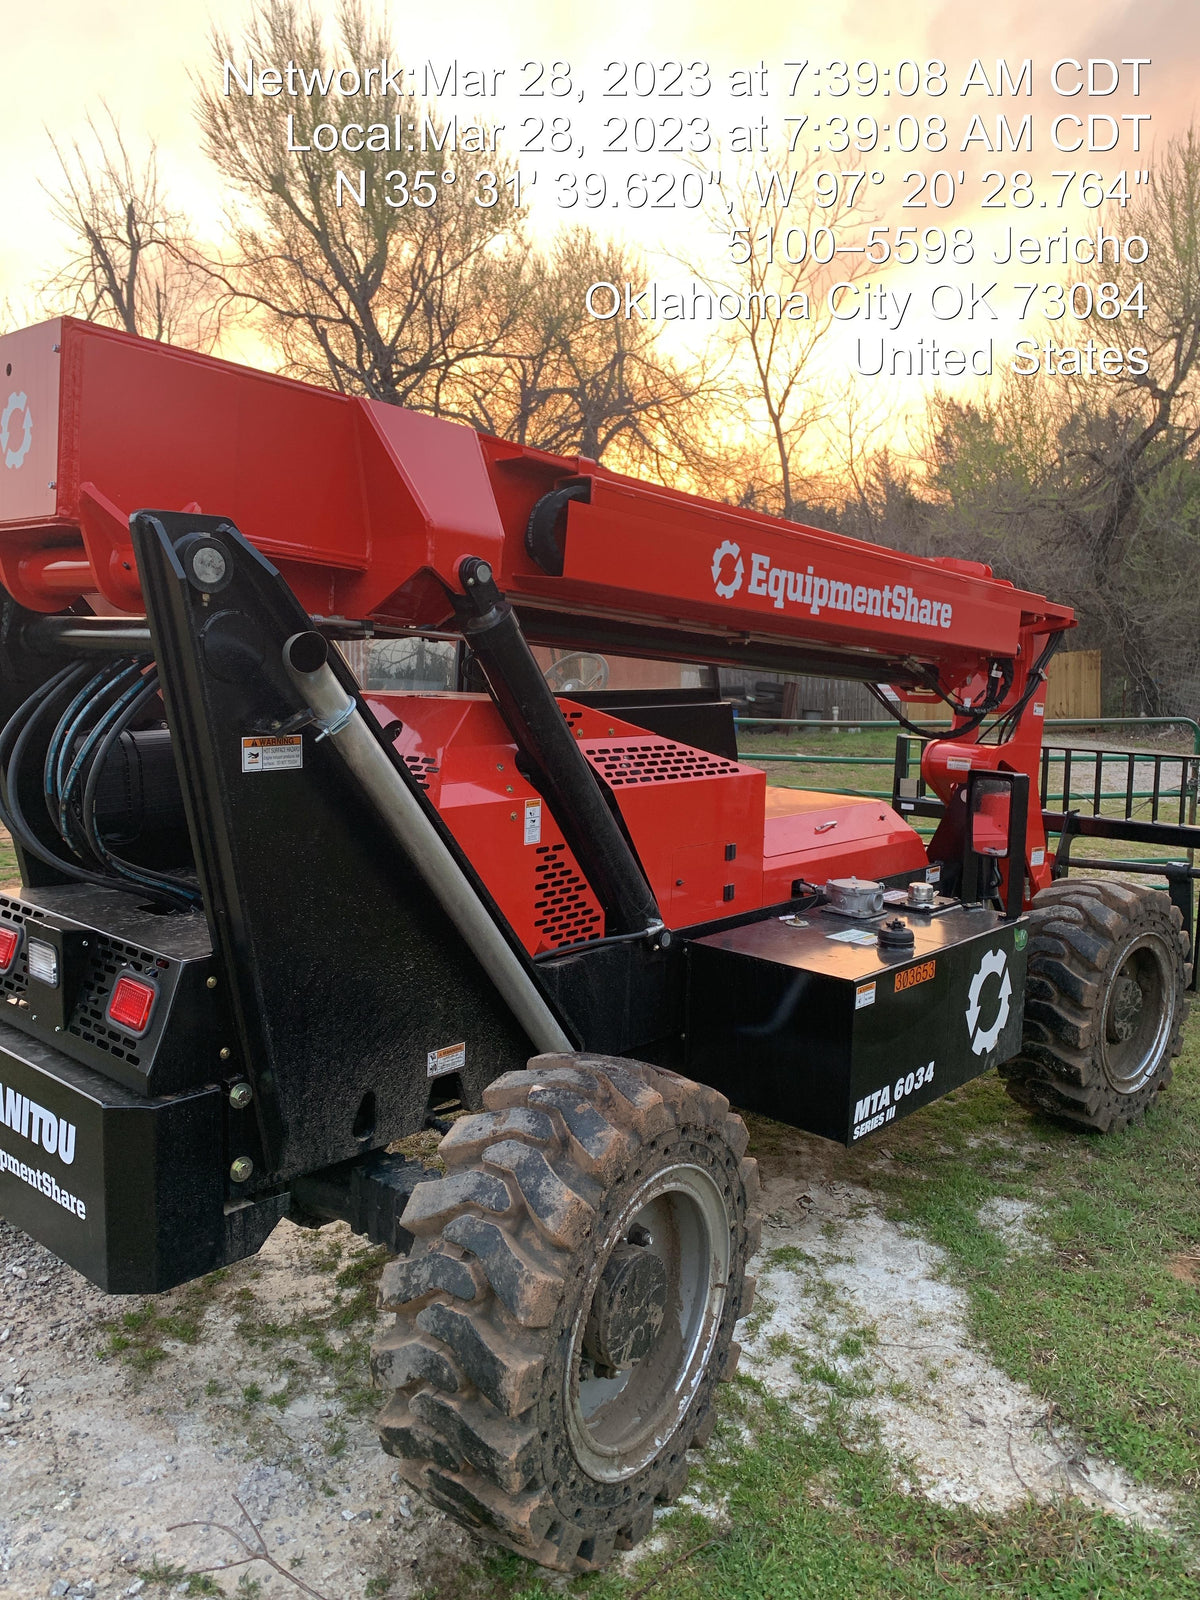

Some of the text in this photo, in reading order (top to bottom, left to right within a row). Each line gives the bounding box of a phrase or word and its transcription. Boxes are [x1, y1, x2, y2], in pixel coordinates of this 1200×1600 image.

[747, 552, 953, 628] EquipmentShare
[260, 737, 295, 747] WARNING
[895, 961, 935, 991] 303653
[853, 1060, 935, 1124] MTA 6034
[852, 1105, 897, 1140] SERIES III
